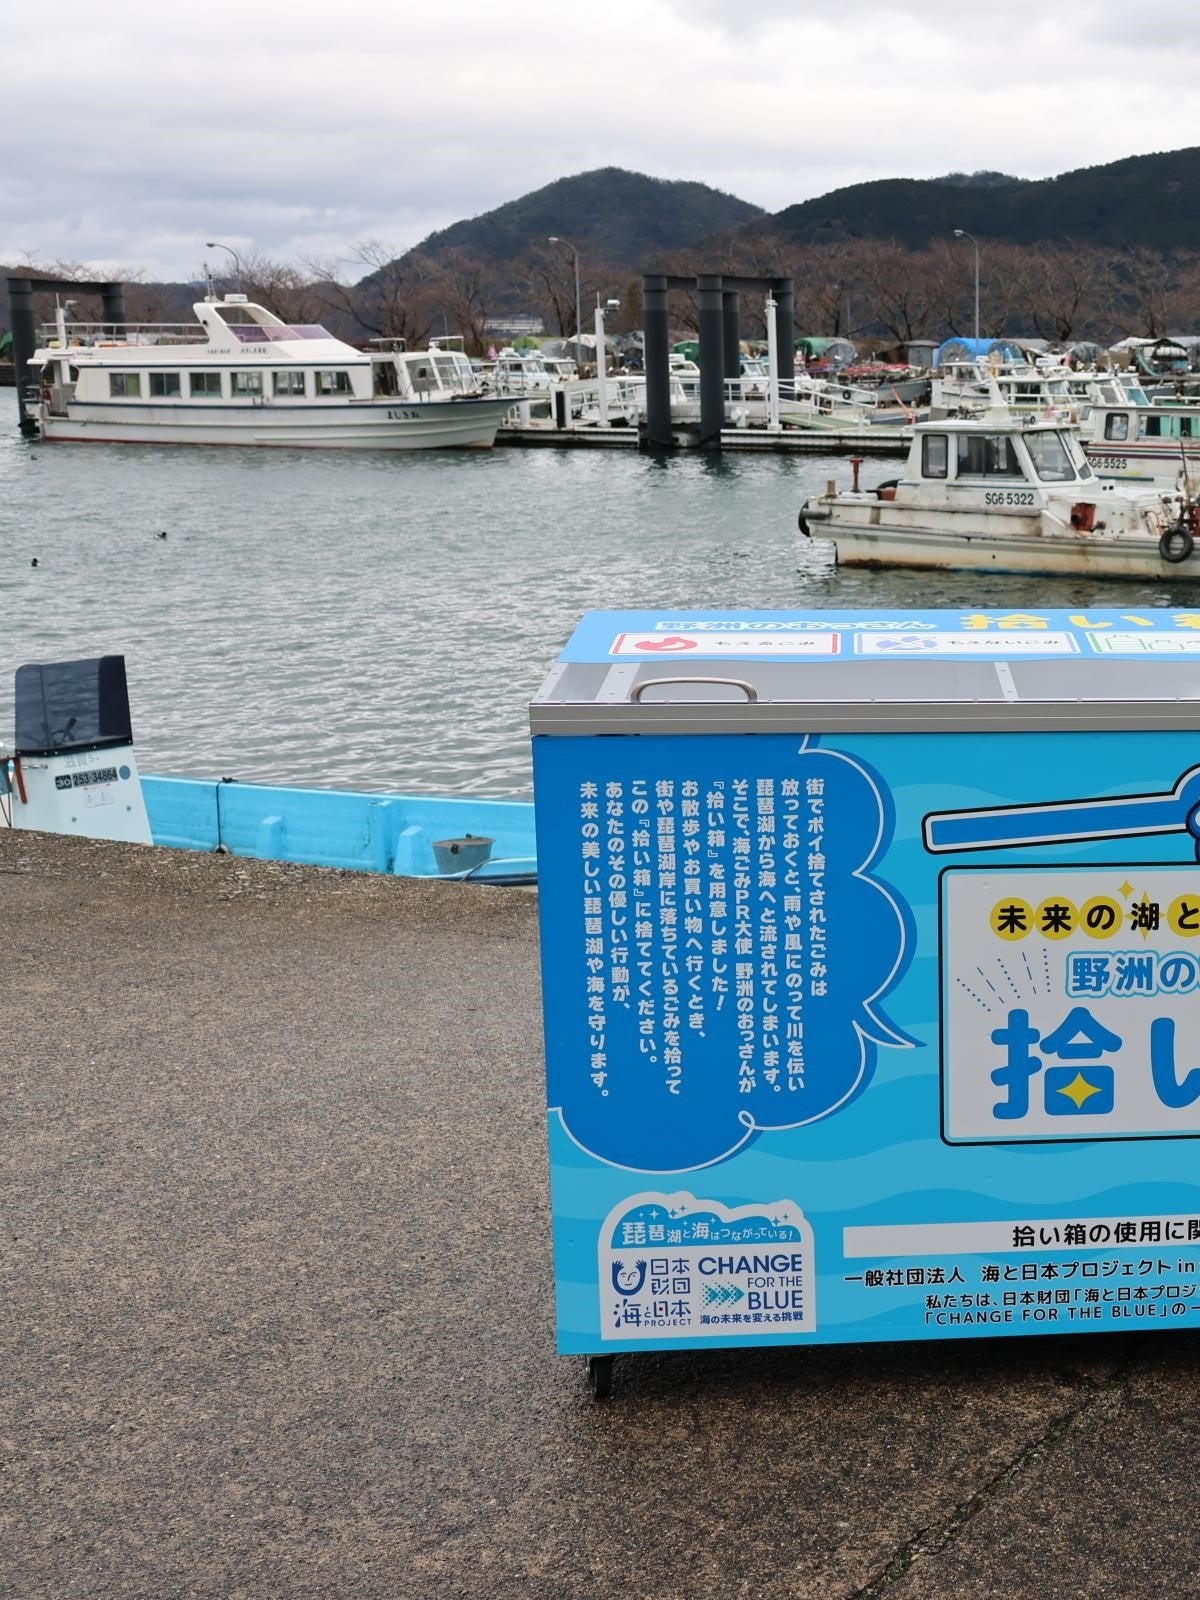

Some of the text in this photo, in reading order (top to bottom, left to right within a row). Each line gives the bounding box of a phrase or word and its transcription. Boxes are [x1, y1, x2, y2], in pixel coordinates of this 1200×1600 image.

[580, 782, 609, 1097] 未来の美しい琵琶湖や海を守ります。
[606, 782, 630, 1008] あなたのその優しい行動が、
[632, 781, 657, 1063] この『拾い箱』に捨ててください。
[656, 781, 682, 1094] 街や琵琶湖岸に落ちているごみを拾って
[682, 781, 706, 1038] お散歩やお買い物へ行くとき、
[732, 780, 757, 1093] そこで、海ごみPR大使 野洲のおっさんが
[756, 779, 780, 1092] 琵琶湖から海へと流されてしまいます。
[782, 779, 805, 1091] 放っておくと、雨や風にのって川を伝い
[807, 779, 827, 996] 街でポイ捨てされたごみは
[644, 1318, 692, 1327] PROJECT
[650, 1257, 691, 1276] 日本
[650, 1277, 691, 1296] 財団
[698, 1254, 803, 1275] CHANGE
[699, 1311, 804, 1325] 海の未来を変える挑戦
[747, 1290, 803, 1310] BLUE
[748, 1275, 803, 1288] FOR THE
[844, 1266, 966, 1288] 一般社団法人
[981, 1257, 1172, 1284] 海と日本プロジェクト
[1178, 1257, 1195, 1273] in
[1022, 1308, 1058, 1321] FOR
[1068, 1306, 1102, 1319] THE
